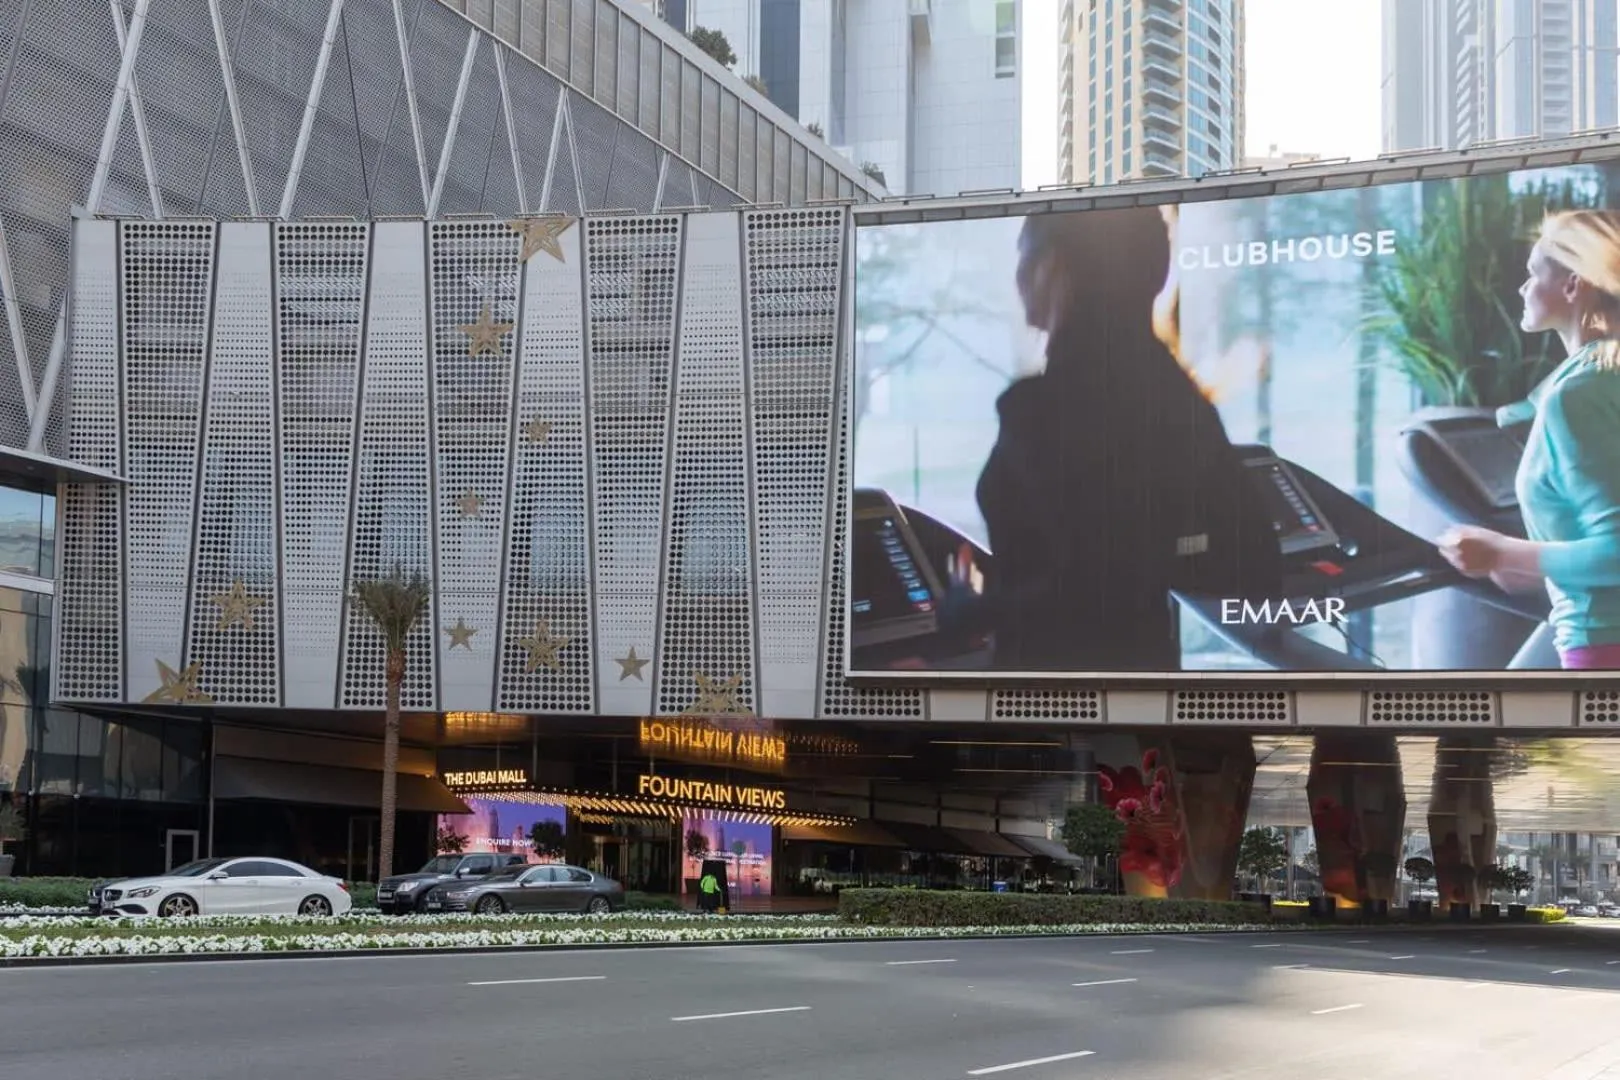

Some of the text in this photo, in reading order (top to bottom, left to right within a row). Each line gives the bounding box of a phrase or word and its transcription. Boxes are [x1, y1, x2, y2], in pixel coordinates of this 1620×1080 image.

[1178, 229, 1396, 270] CLUBHOUSE
[1221, 597, 1348, 624] EMAAR
[444, 769, 527, 785] THE DUBAI MALL
[640, 775, 785, 808] FOUNTAIN VIEWS
